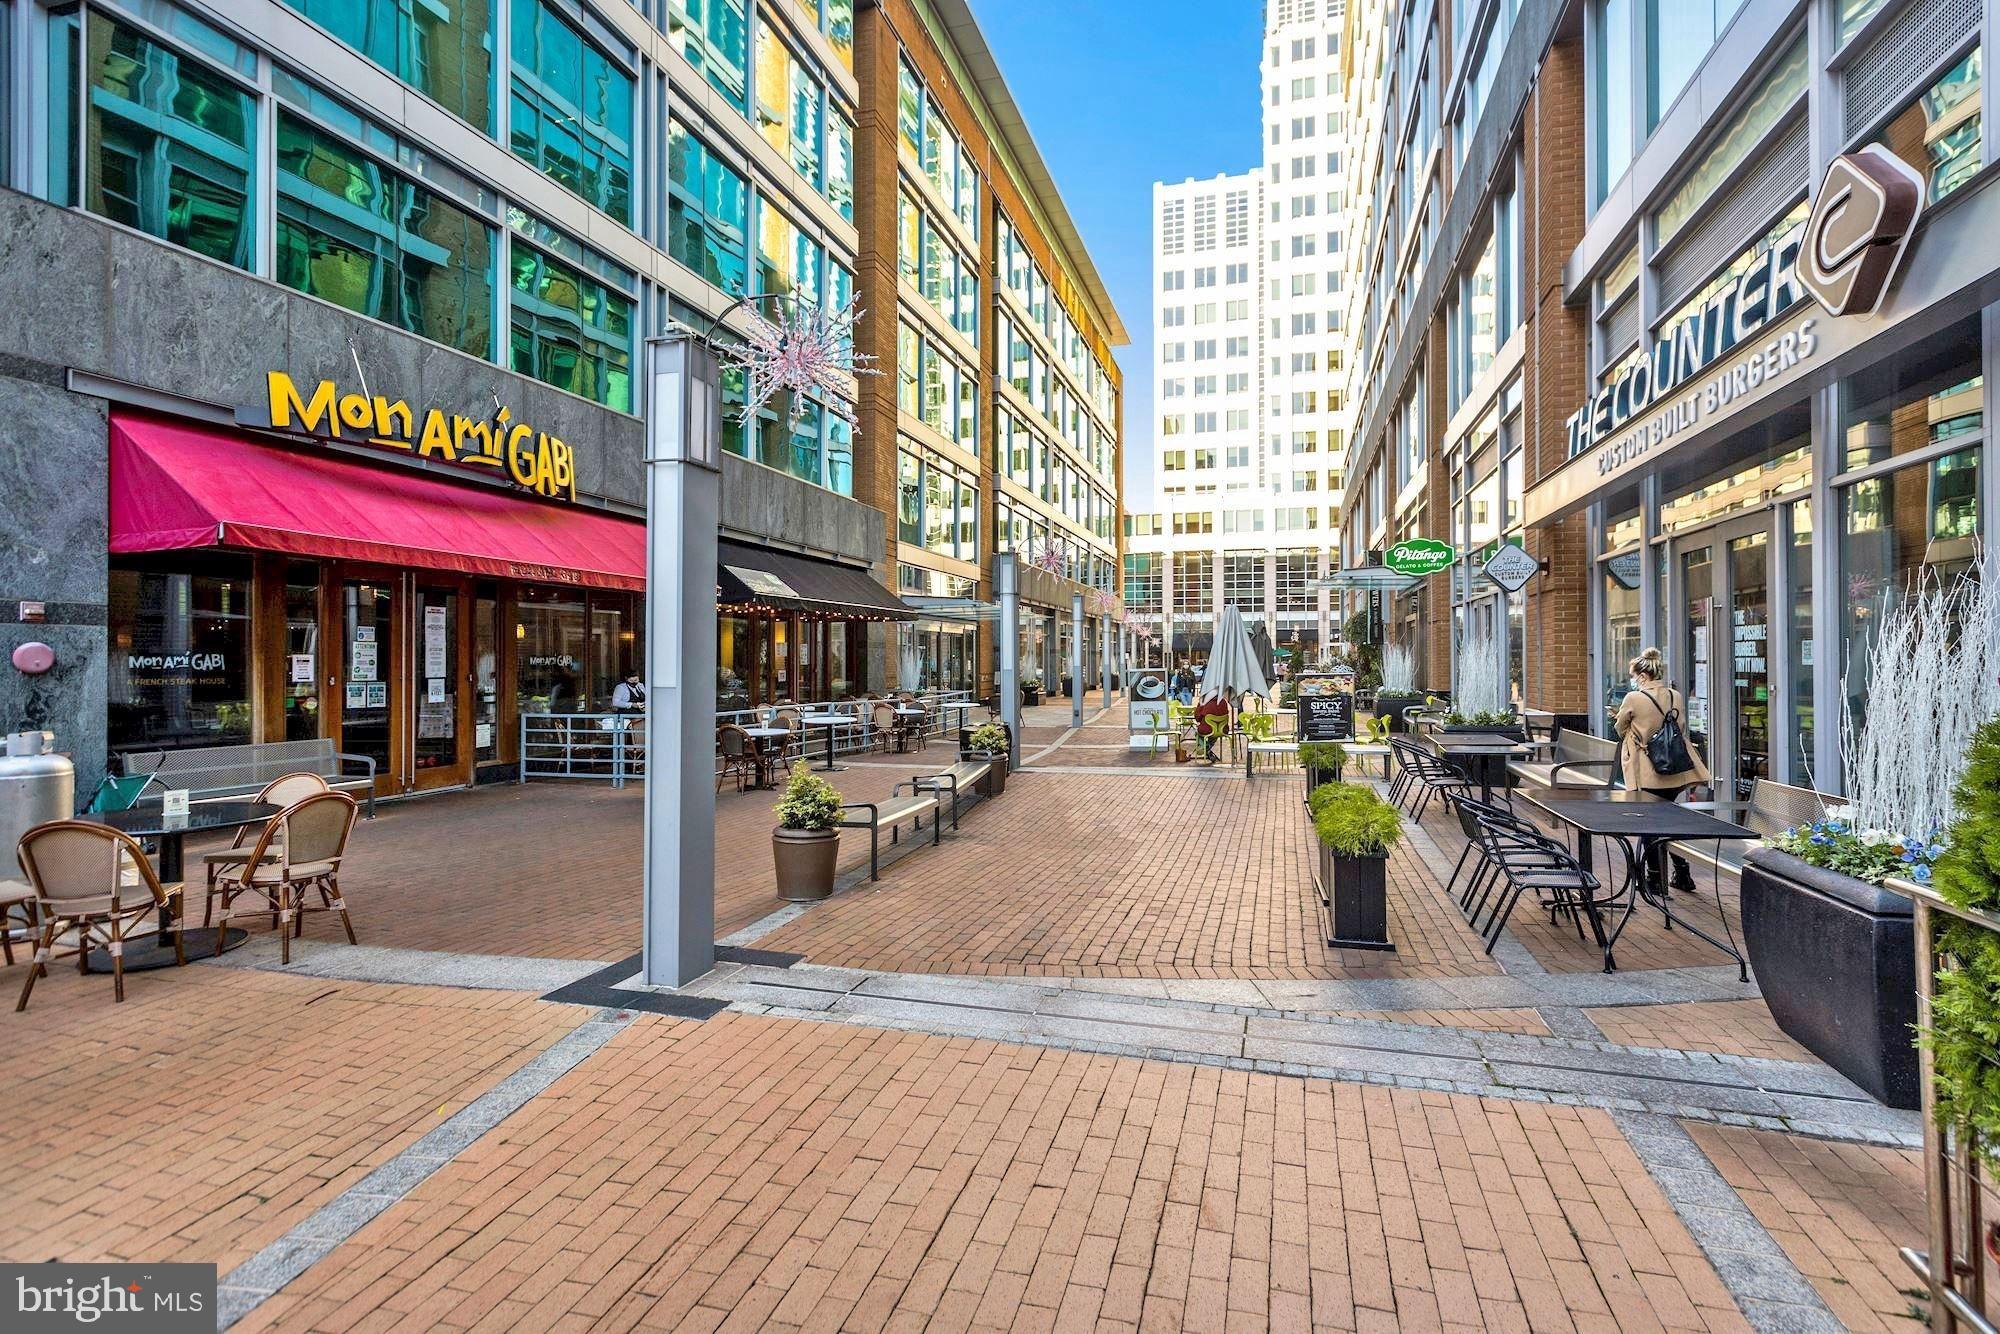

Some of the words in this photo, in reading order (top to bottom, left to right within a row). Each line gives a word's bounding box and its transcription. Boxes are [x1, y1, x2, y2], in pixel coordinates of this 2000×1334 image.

[1566, 384, 1612, 460] THE
[1612, 220, 1811, 428] COUNTER
[1598, 425, 1649, 476] CUSTOM
[1651, 392, 1700, 446] BUILT
[1705, 319, 1816, 415] BURGERS
[267, 370, 412, 449] Mon
[508, 423, 577, 503] GABI
[1393, 546, 1447, 563] Pitango
[1503, 556, 1521, 564] THE
[1491, 562, 1534, 571] COUNTER
[1734, 610, 1746, 626] THE
[1734, 624, 1767, 641] IMPOSSIBLE
[128, 655, 162, 670] Mon
[191, 653, 226, 671] GABI
[557, 654, 573, 666] GABI
[170, 678, 198, 686] STEAK
[200, 677, 226, 685] HOUSE
